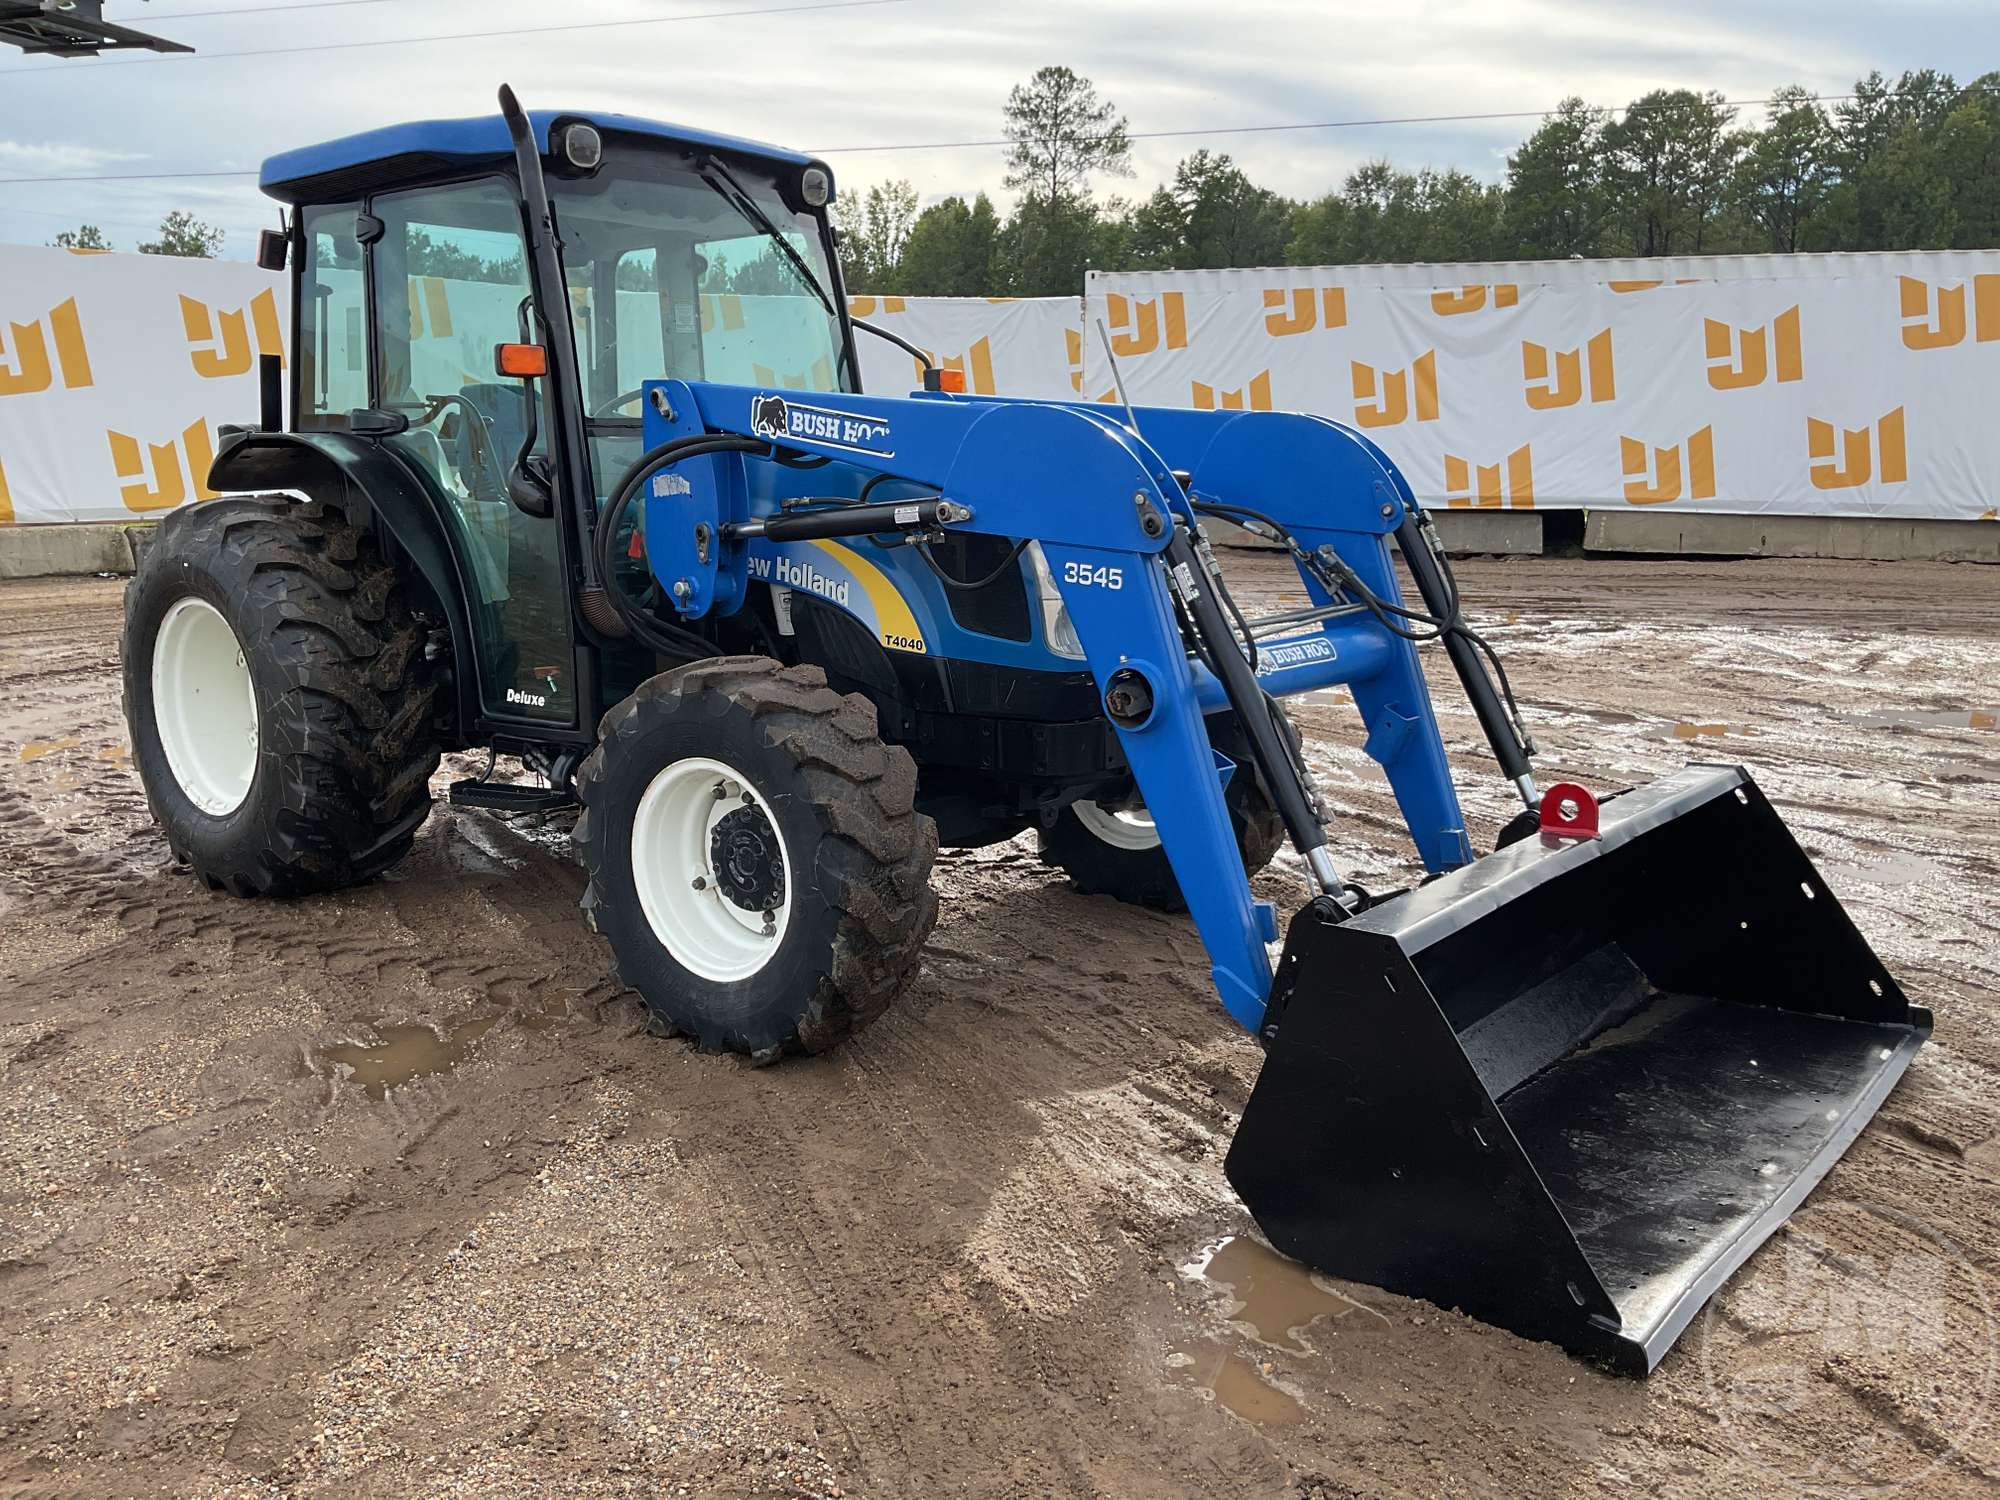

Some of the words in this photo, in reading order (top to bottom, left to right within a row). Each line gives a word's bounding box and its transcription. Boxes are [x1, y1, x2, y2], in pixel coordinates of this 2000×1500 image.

[791, 411, 840, 439] BUSH
[747, 556, 772, 578] ew
[776, 555, 849, 607] Holland
[1064, 562, 1123, 590] 3545
[884, 634, 923, 651] T4040
[1272, 645, 1306, 664] BUSH
[1302, 641, 1331, 660] HOG
[506, 688, 546, 707] Deluxe
